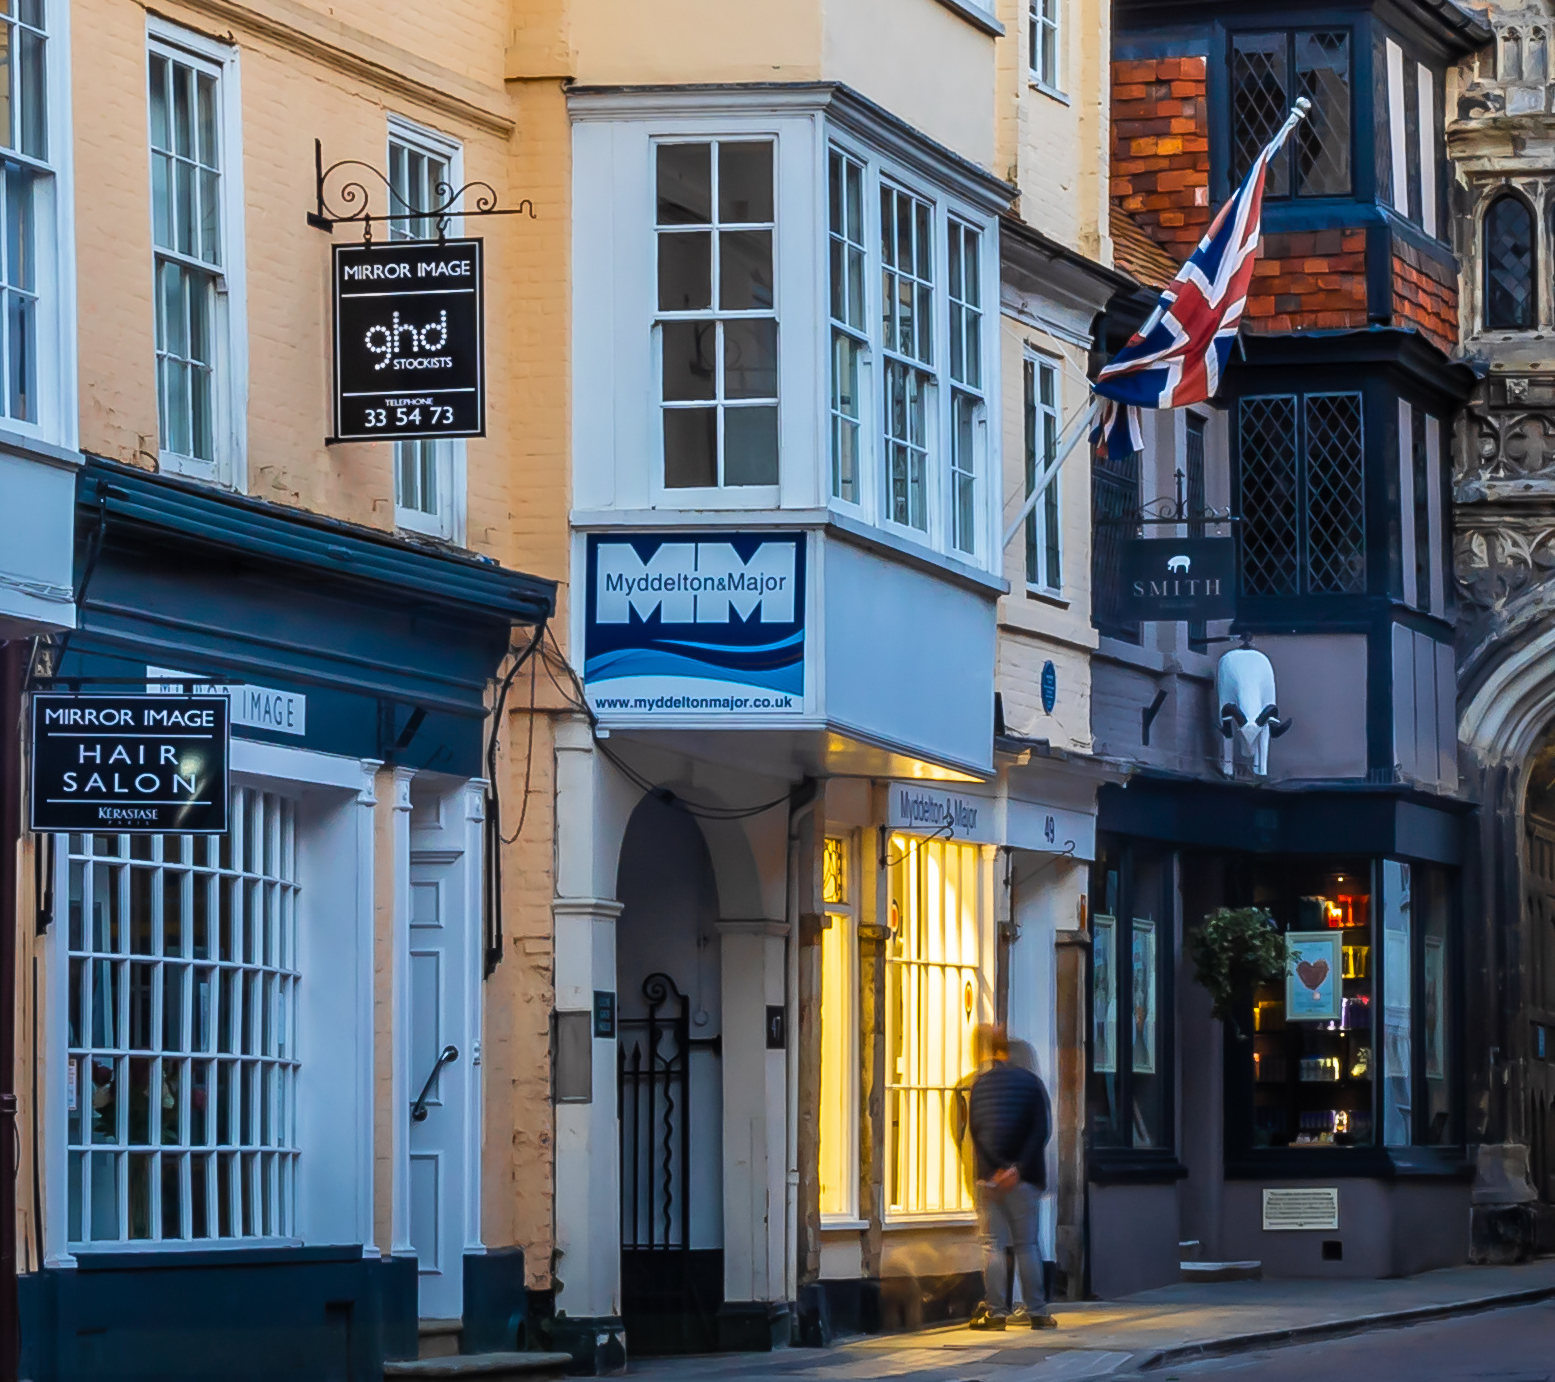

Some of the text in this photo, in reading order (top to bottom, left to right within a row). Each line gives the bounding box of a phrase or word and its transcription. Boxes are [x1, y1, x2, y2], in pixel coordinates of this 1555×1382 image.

[344, 260, 471, 280] MIRROR IMAGE
[365, 310, 447, 370] ghd
[393, 356, 453, 370] STOCKISTS
[385, 397, 433, 406] TELEPHONE
[364, 406, 453, 427] 33 54 73
[606, 572, 787, 596] Myddelton&Major
[1133, 579, 1221, 597] SMITH
[242, 689, 295, 727] IMAGE
[595, 695, 793, 712] www.myddeltonmajor.co.uk
[45, 708, 215, 727] MIRROR IMAGE
[78, 744, 179, 765] HAIR
[62, 772, 195, 794] SALON
[900, 790, 944, 827] Myddelton
[954, 799, 978, 835] Major
[1044, 815, 1056, 843] 49
